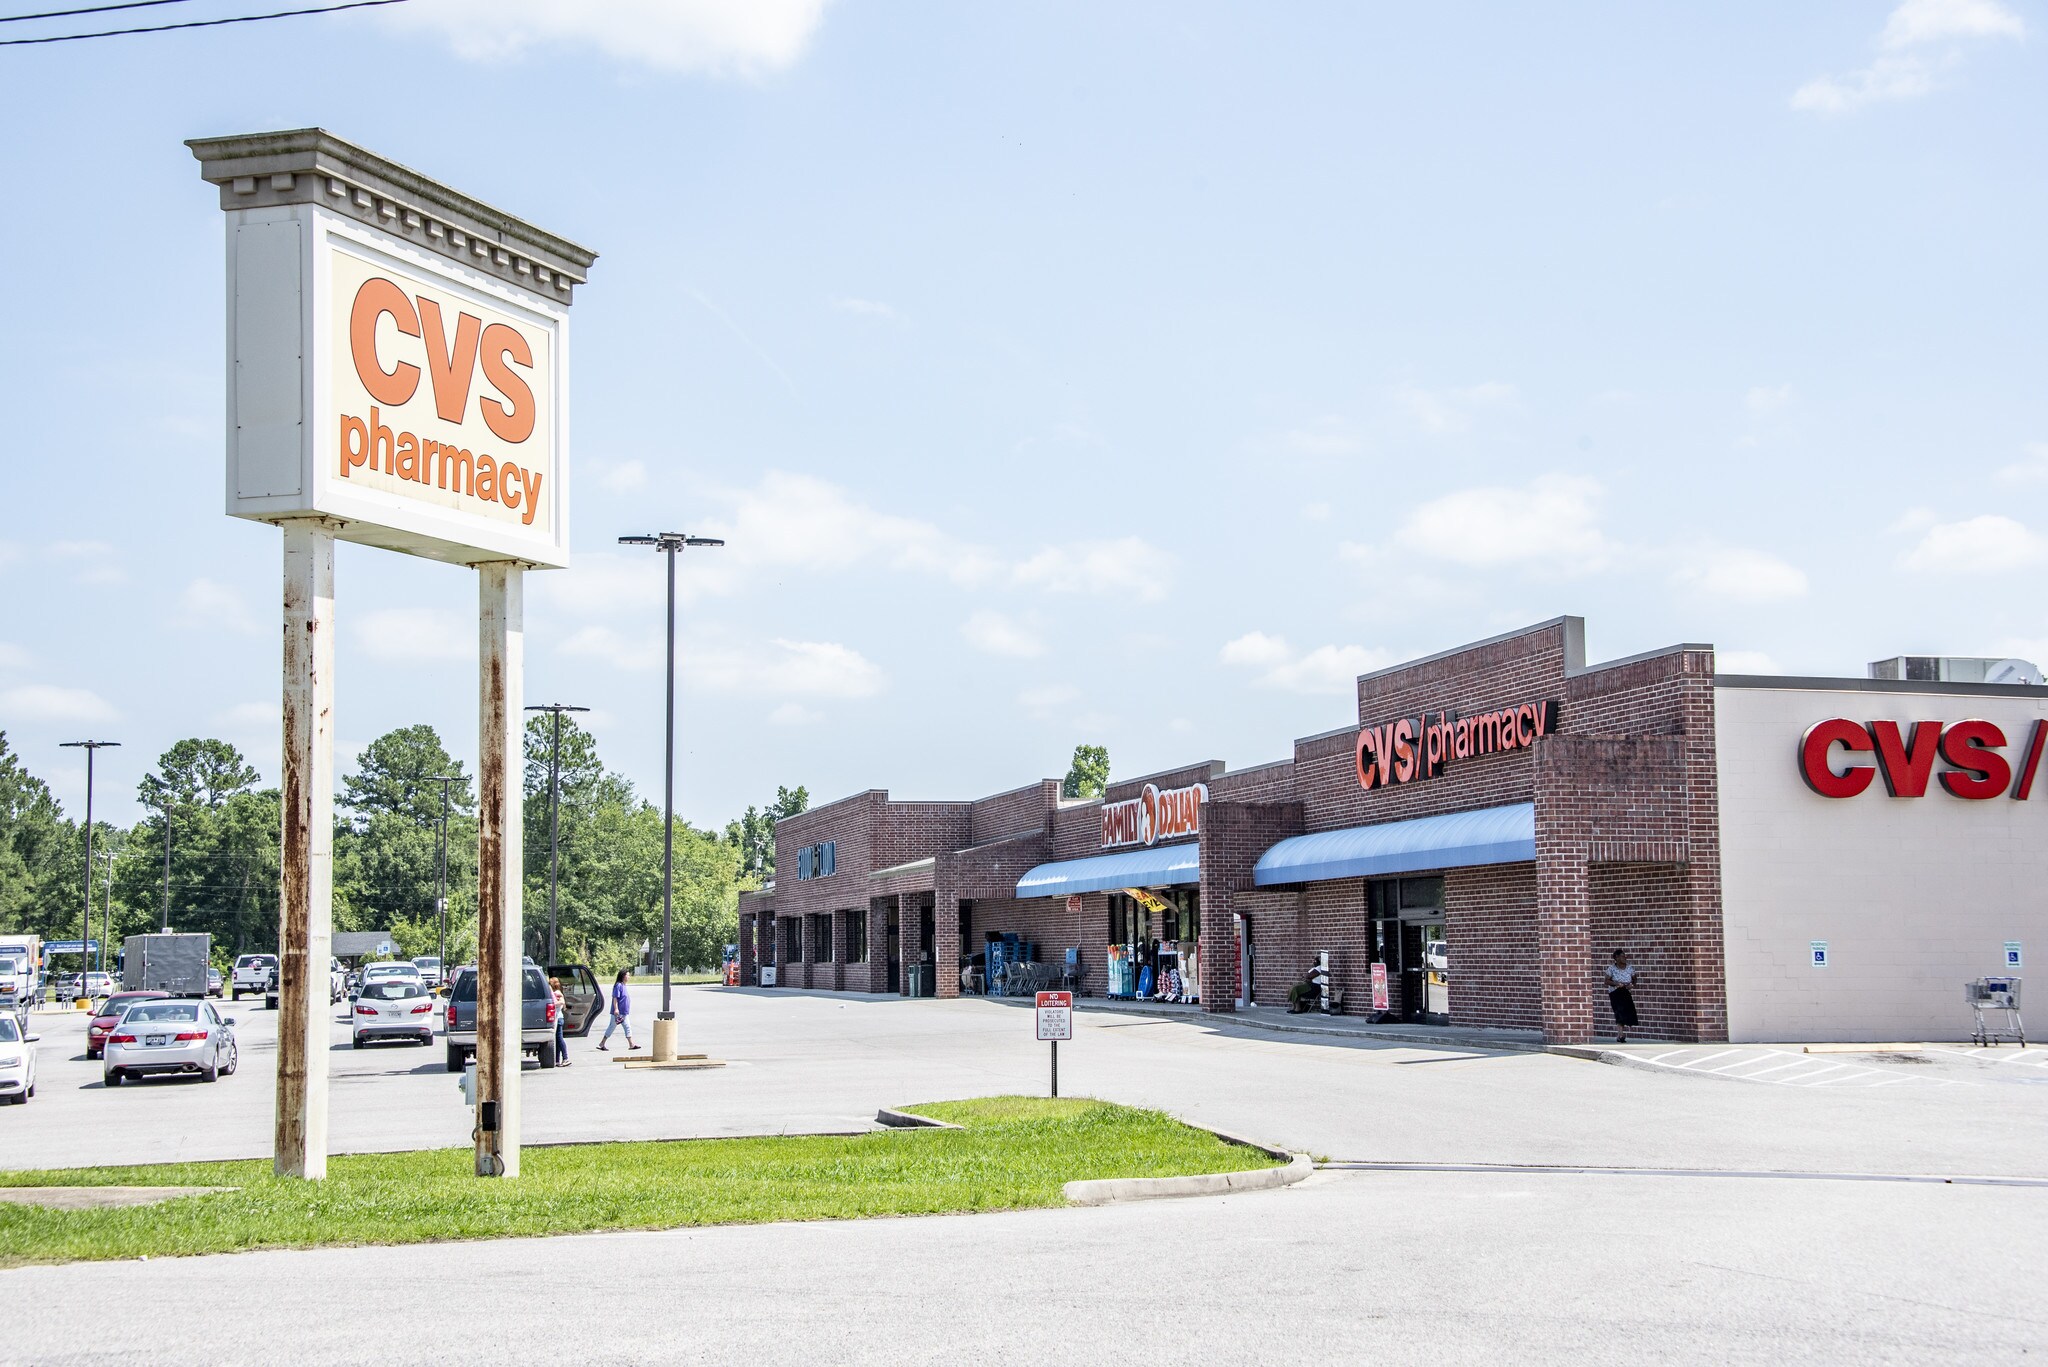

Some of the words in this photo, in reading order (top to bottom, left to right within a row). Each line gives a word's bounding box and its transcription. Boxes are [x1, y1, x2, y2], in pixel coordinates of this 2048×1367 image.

[349, 277, 536, 443] CVS
[340, 405, 543, 525] pharmacy
[1101, 801, 1140, 846] FAMILY
